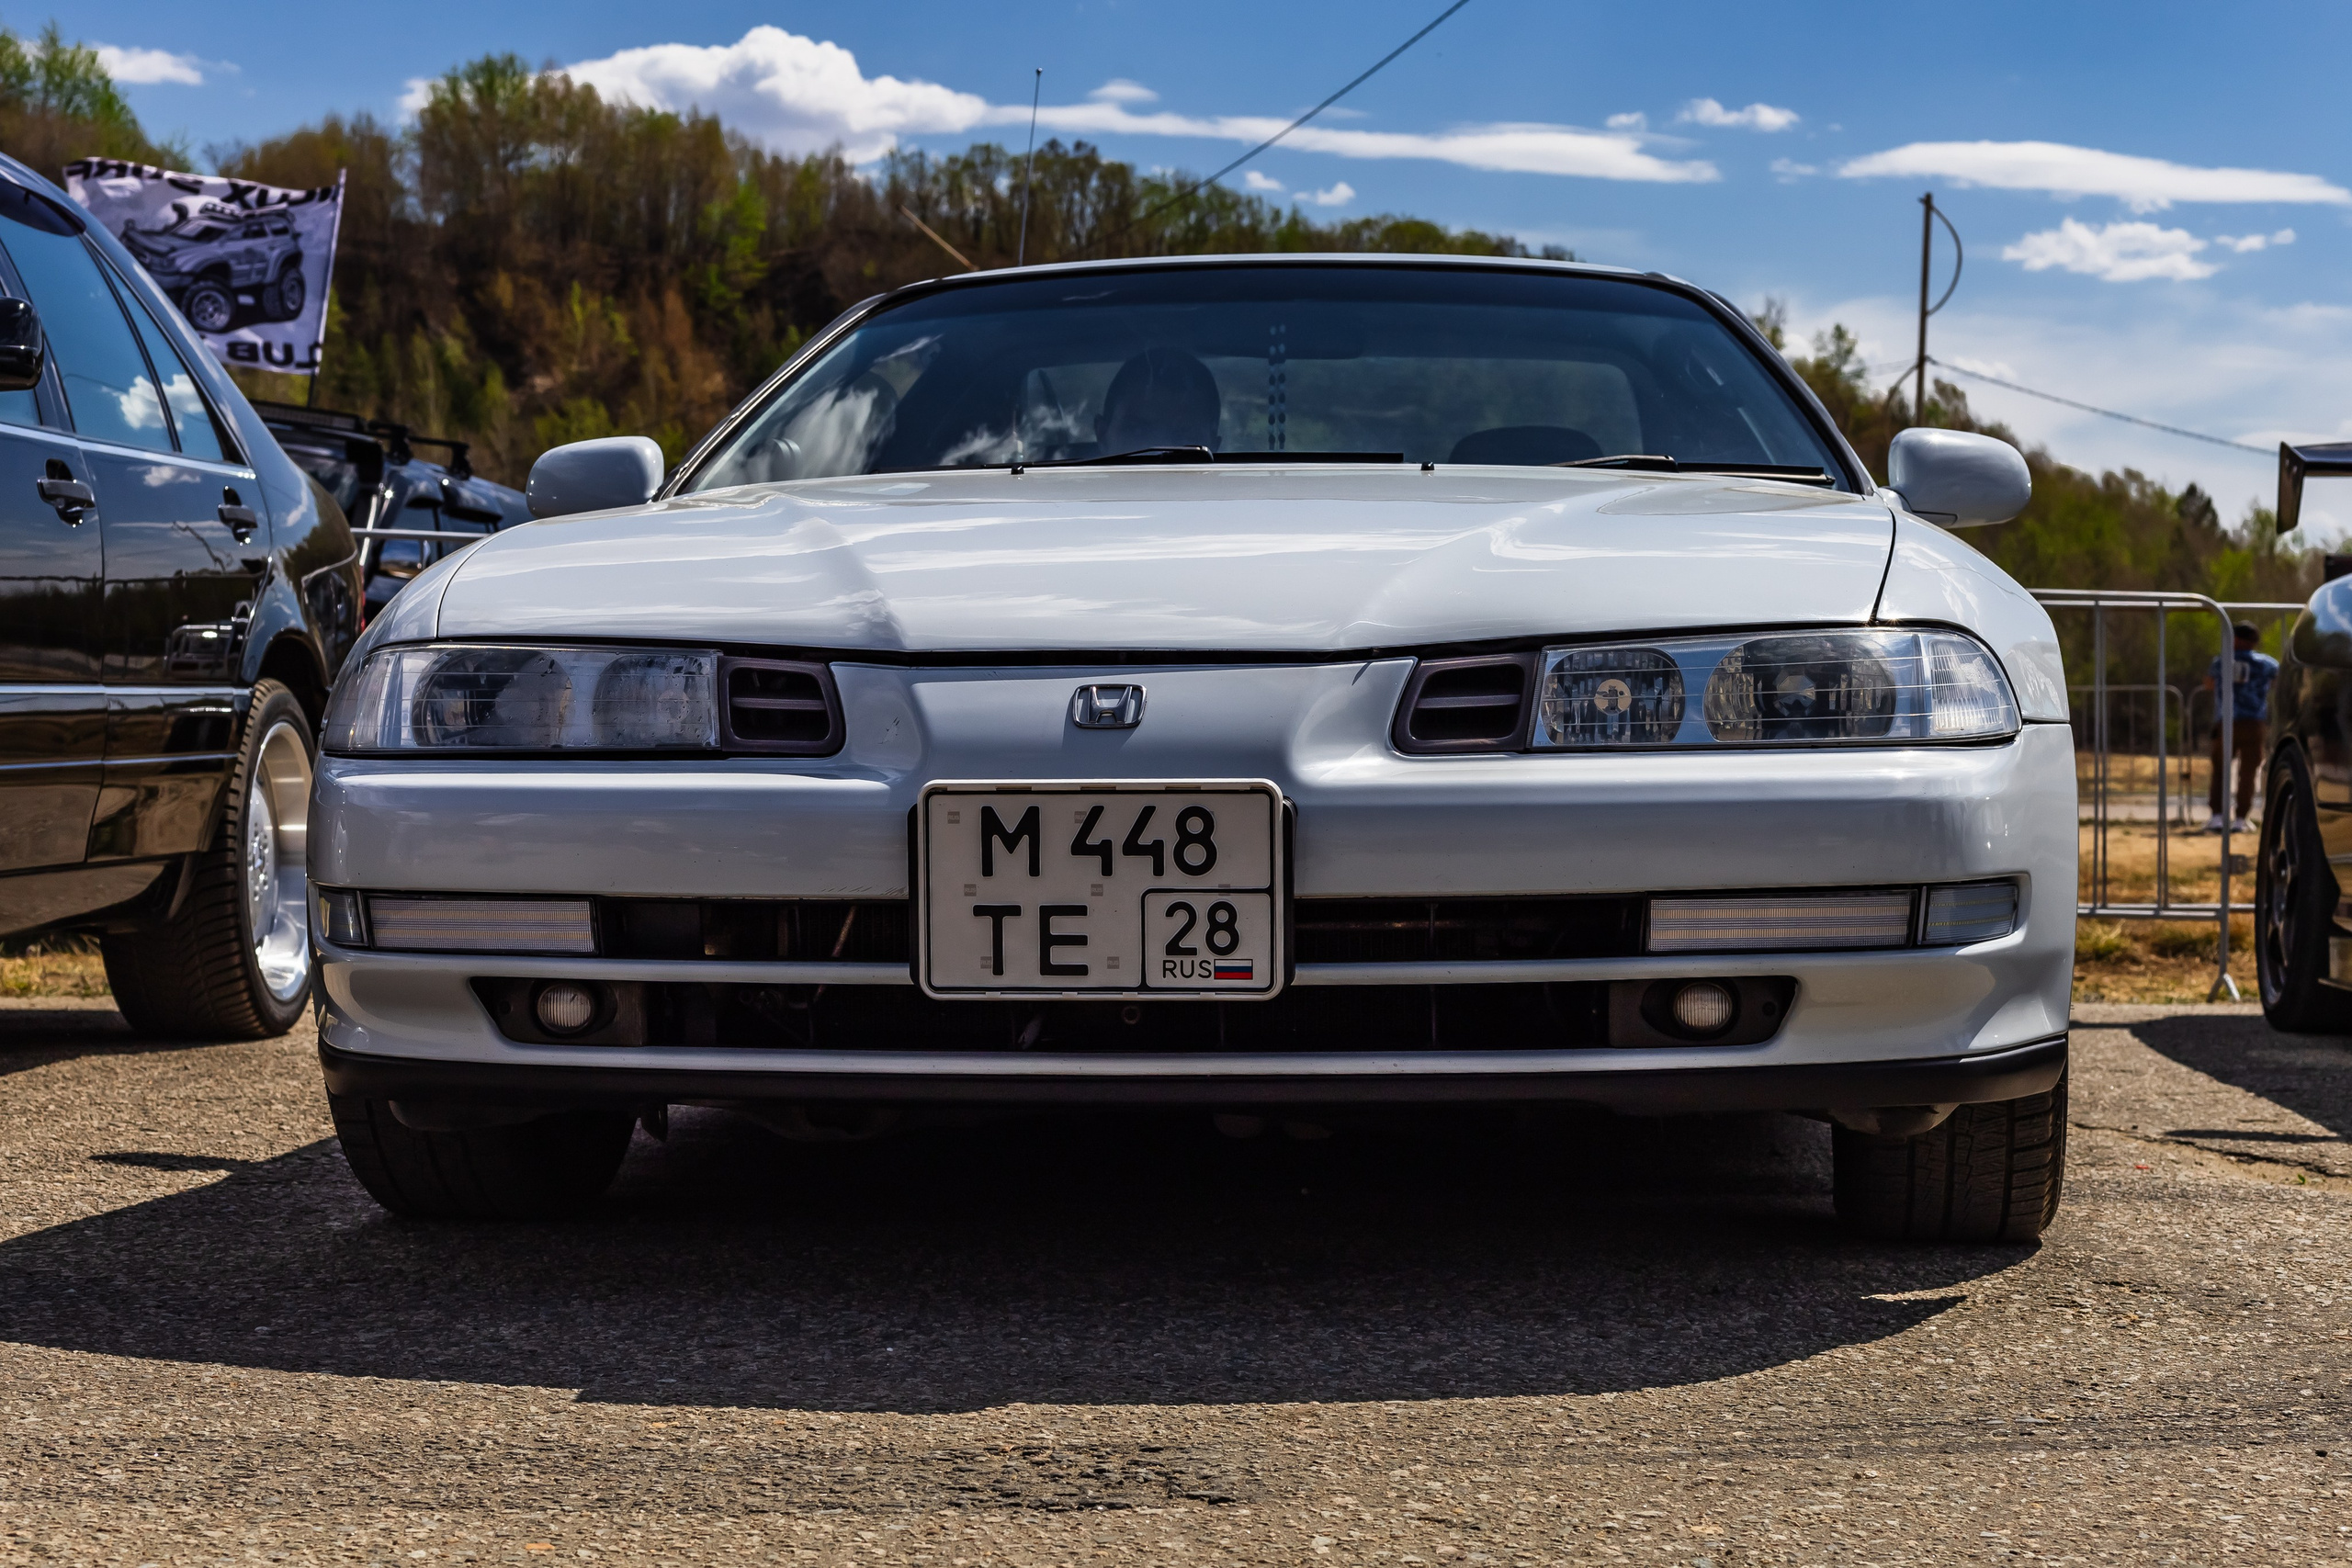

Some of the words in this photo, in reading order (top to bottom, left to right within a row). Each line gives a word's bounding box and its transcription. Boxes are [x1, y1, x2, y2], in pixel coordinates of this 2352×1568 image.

[980, 805, 1041, 877] M
[1070, 805, 1217, 877] 448
[973, 904, 1089, 976] TE
[1165, 901, 1239, 956] 28
[1162, 959, 1213, 979] RUS
